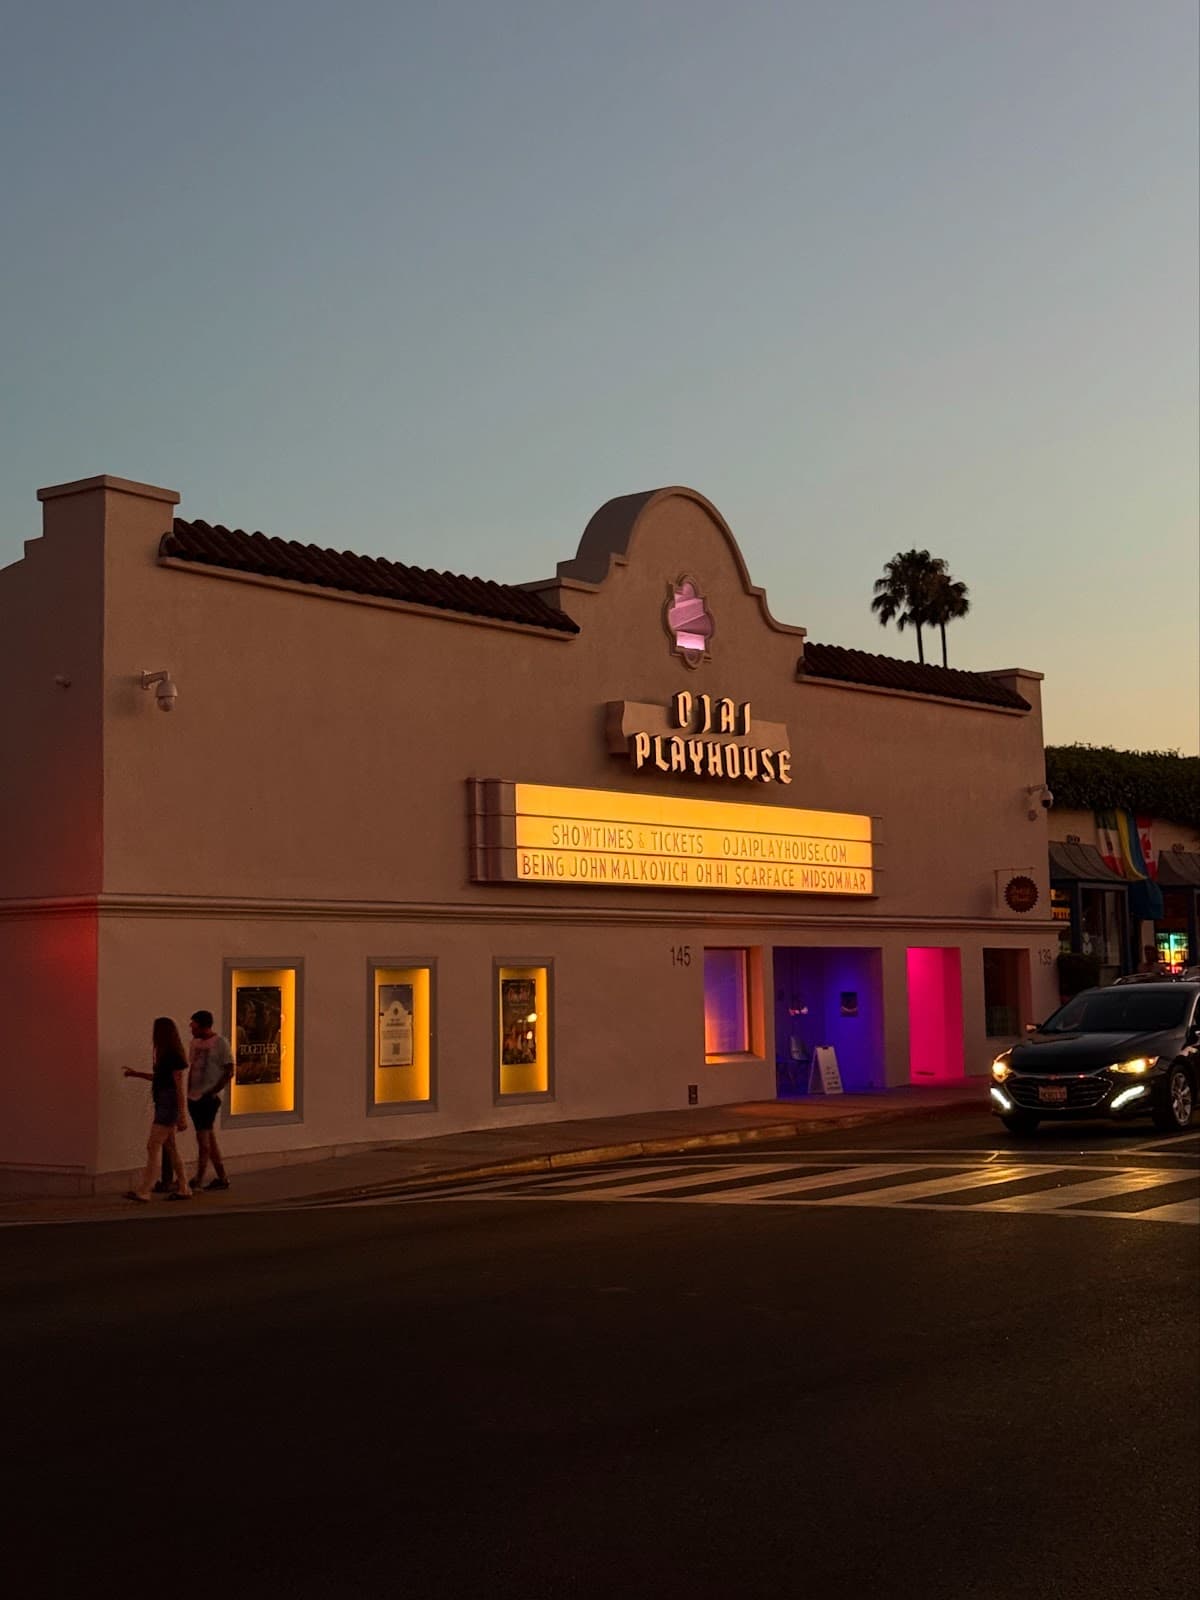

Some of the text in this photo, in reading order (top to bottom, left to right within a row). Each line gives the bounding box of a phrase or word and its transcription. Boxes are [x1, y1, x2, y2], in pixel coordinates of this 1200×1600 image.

[676, 690, 751, 735] OJAI
[634, 731, 793, 784] PLAYHOUSE
[552, 824, 847, 863] SHOWTIMES & TICKETS OJAIPLAYHOUSE.COM
[522, 854, 866, 890] BEING JOHN MALKOVICH OH HI SCARFACE MIDSOMMAR
[670, 945, 691, 967] 145
[239, 1042, 278, 1055] TOGETHER
